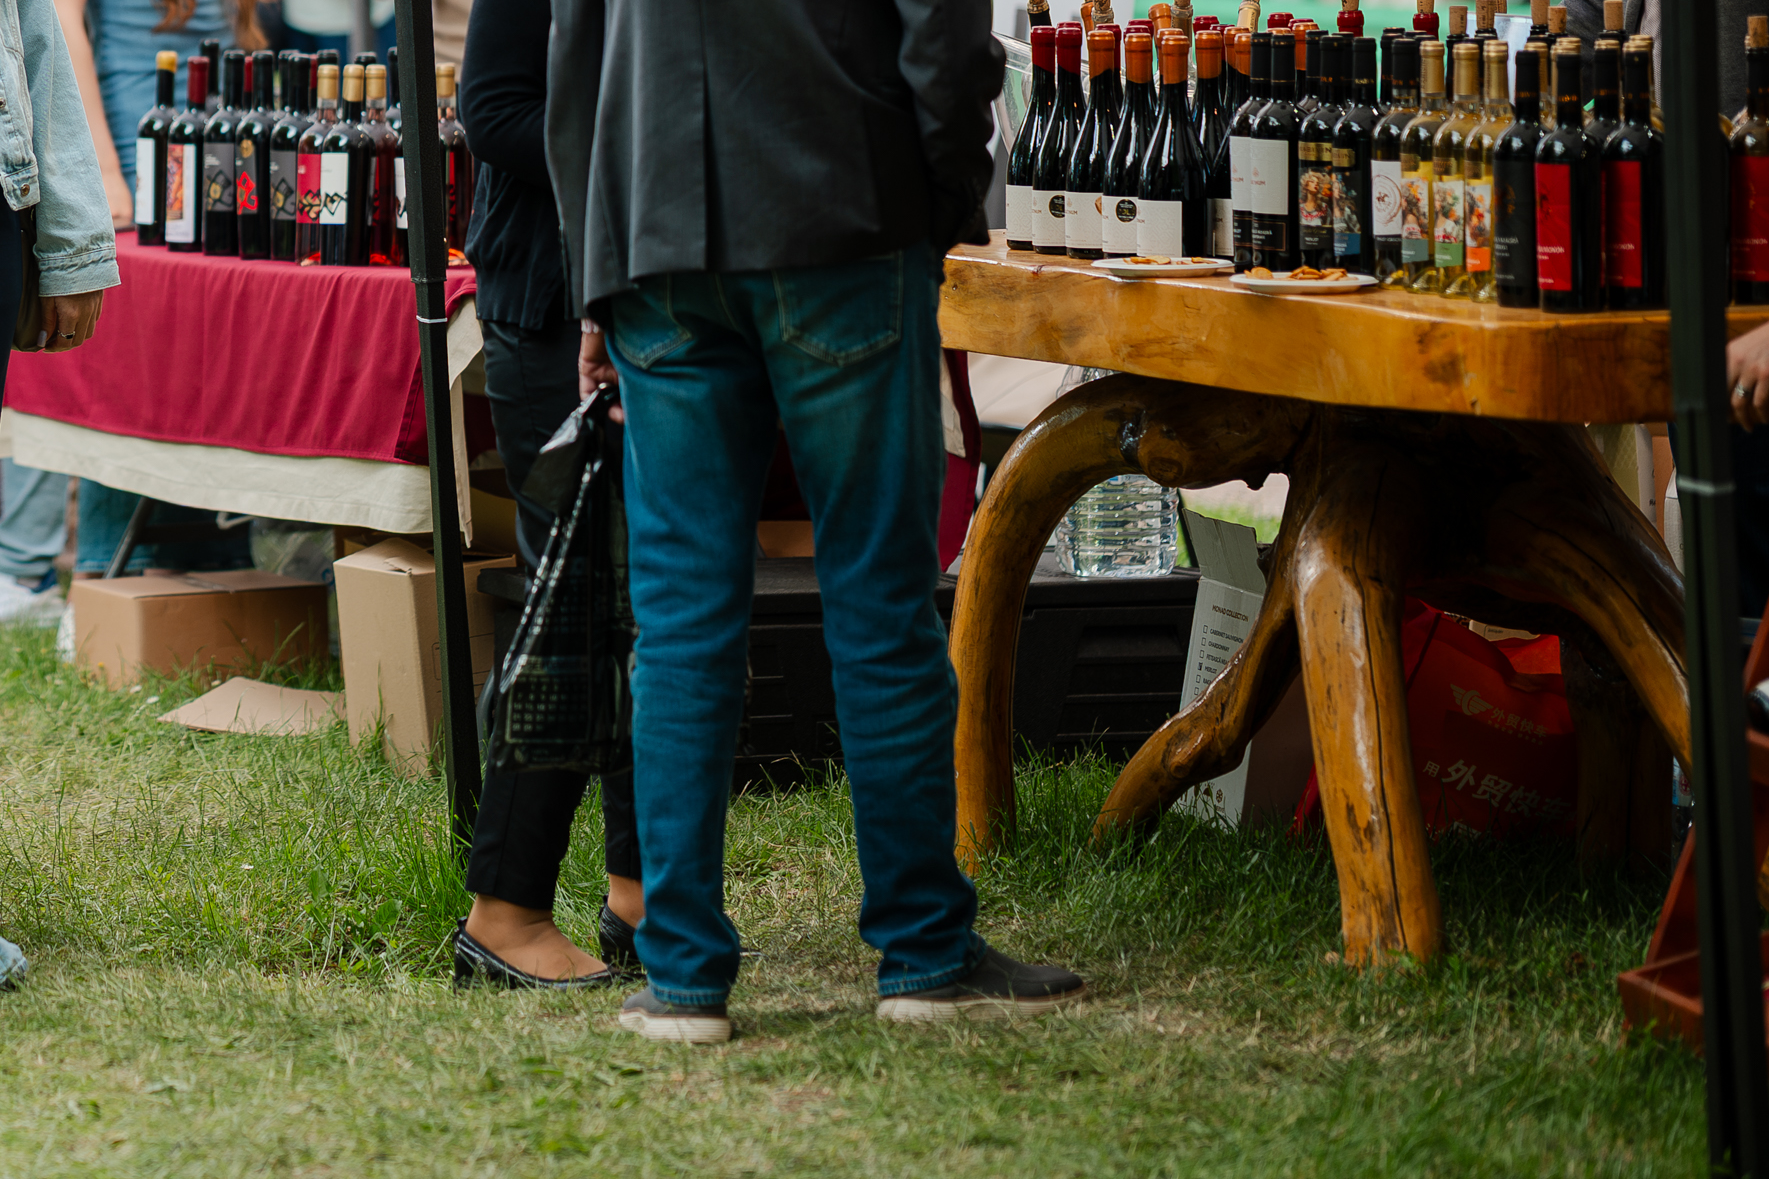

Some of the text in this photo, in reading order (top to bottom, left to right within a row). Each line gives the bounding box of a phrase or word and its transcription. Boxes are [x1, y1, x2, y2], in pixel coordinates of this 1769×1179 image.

[1226, 609, 1249, 623] COLLECTION
[1490, 707, 1549, 738] 外贸快车
